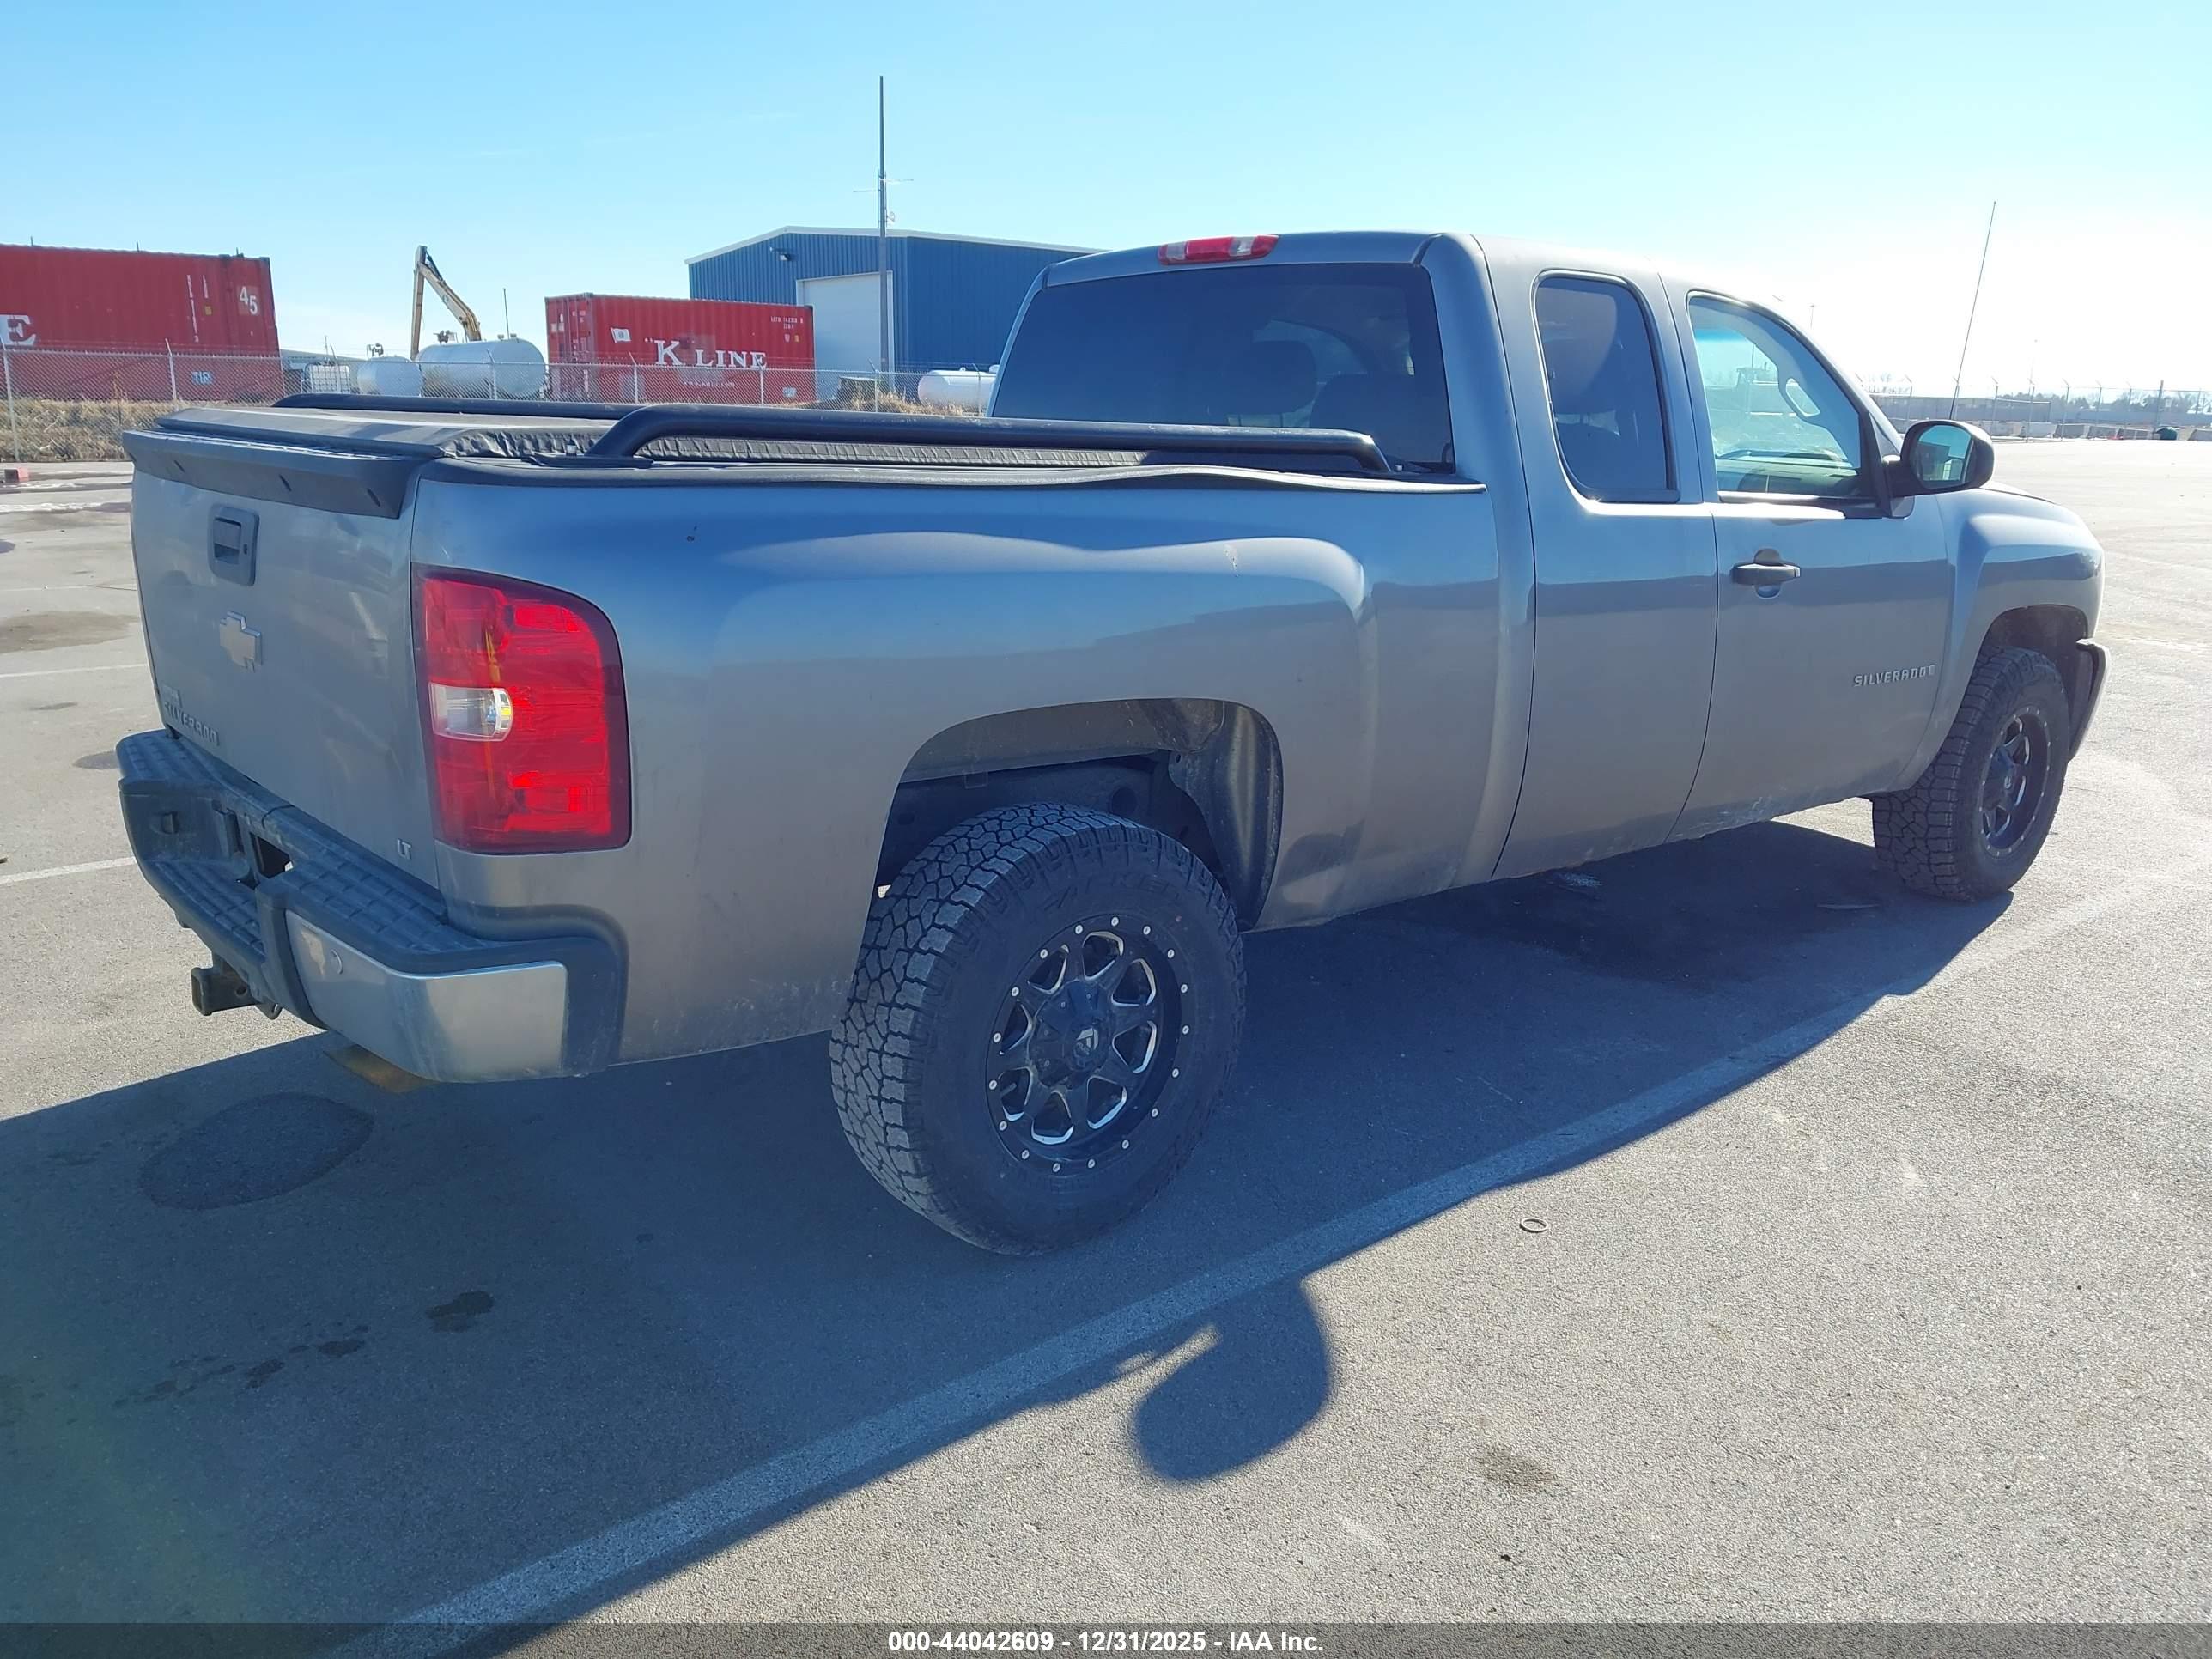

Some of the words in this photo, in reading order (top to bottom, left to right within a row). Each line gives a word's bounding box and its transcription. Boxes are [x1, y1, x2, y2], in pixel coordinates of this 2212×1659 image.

[240, 286, 258, 315] 45
[0, 314, 36, 345] E
[695, 349, 768, 370] LINE
[1853, 665, 1927, 687] SILVERADO
[398, 838, 412, 860] LT
